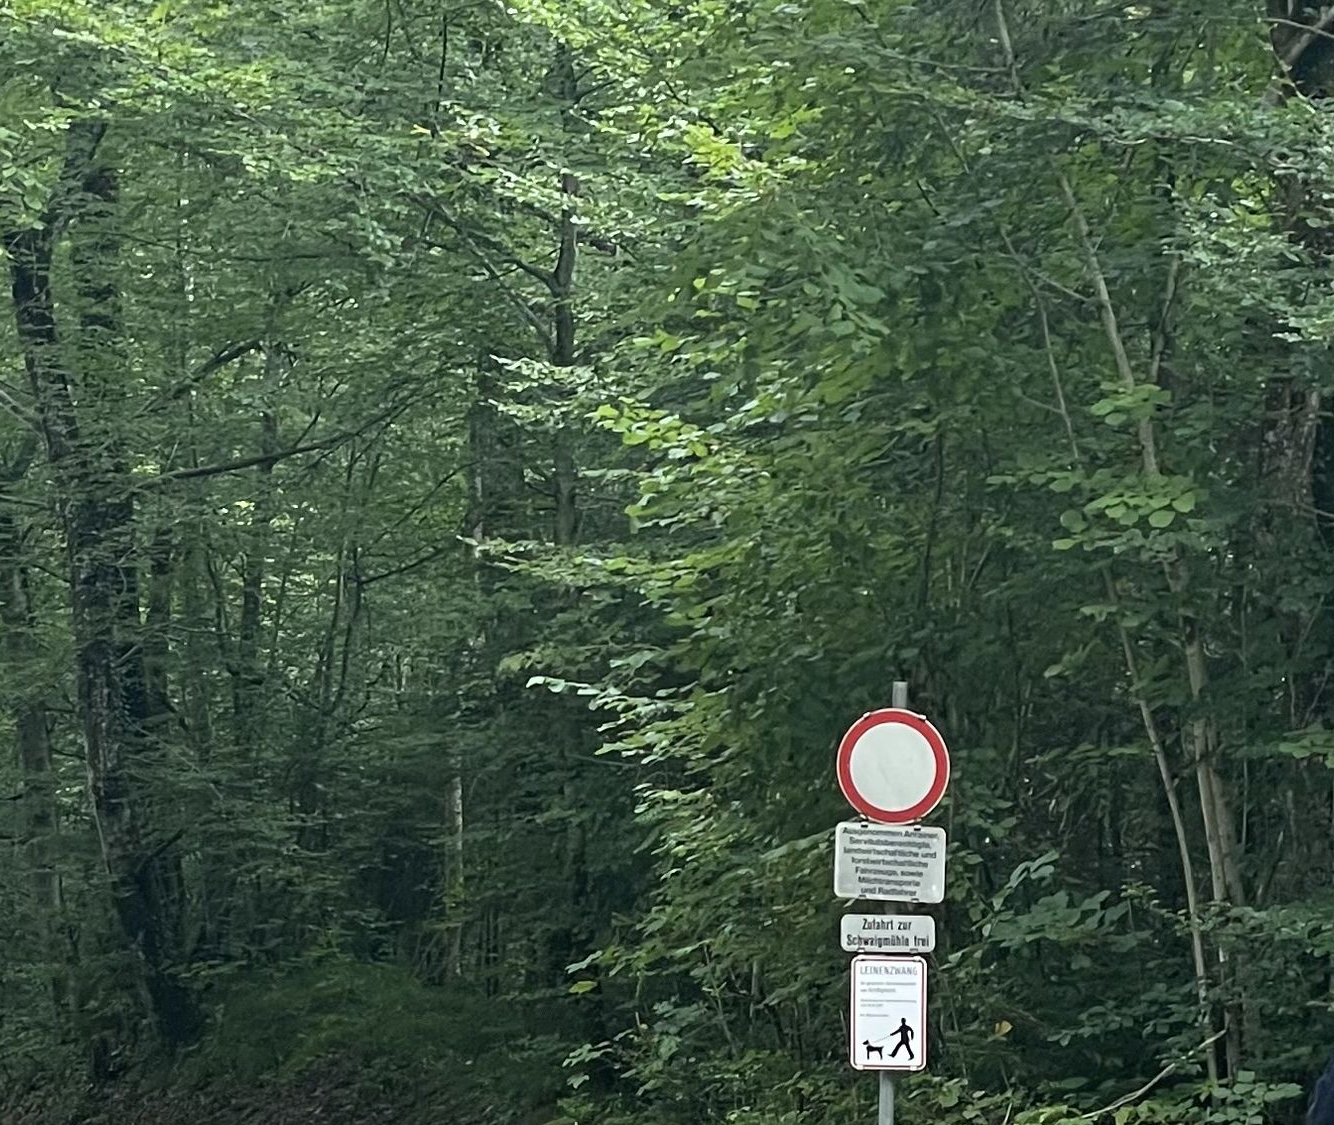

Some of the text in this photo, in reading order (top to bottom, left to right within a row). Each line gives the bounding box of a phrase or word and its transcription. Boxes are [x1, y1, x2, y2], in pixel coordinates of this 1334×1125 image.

[921, 851, 937, 859] und
[862, 918, 912, 930] Zufahrt zur
[847, 934, 929, 948] Schwaigmühle frei
[859, 965, 918, 976] LEINENZWANG
